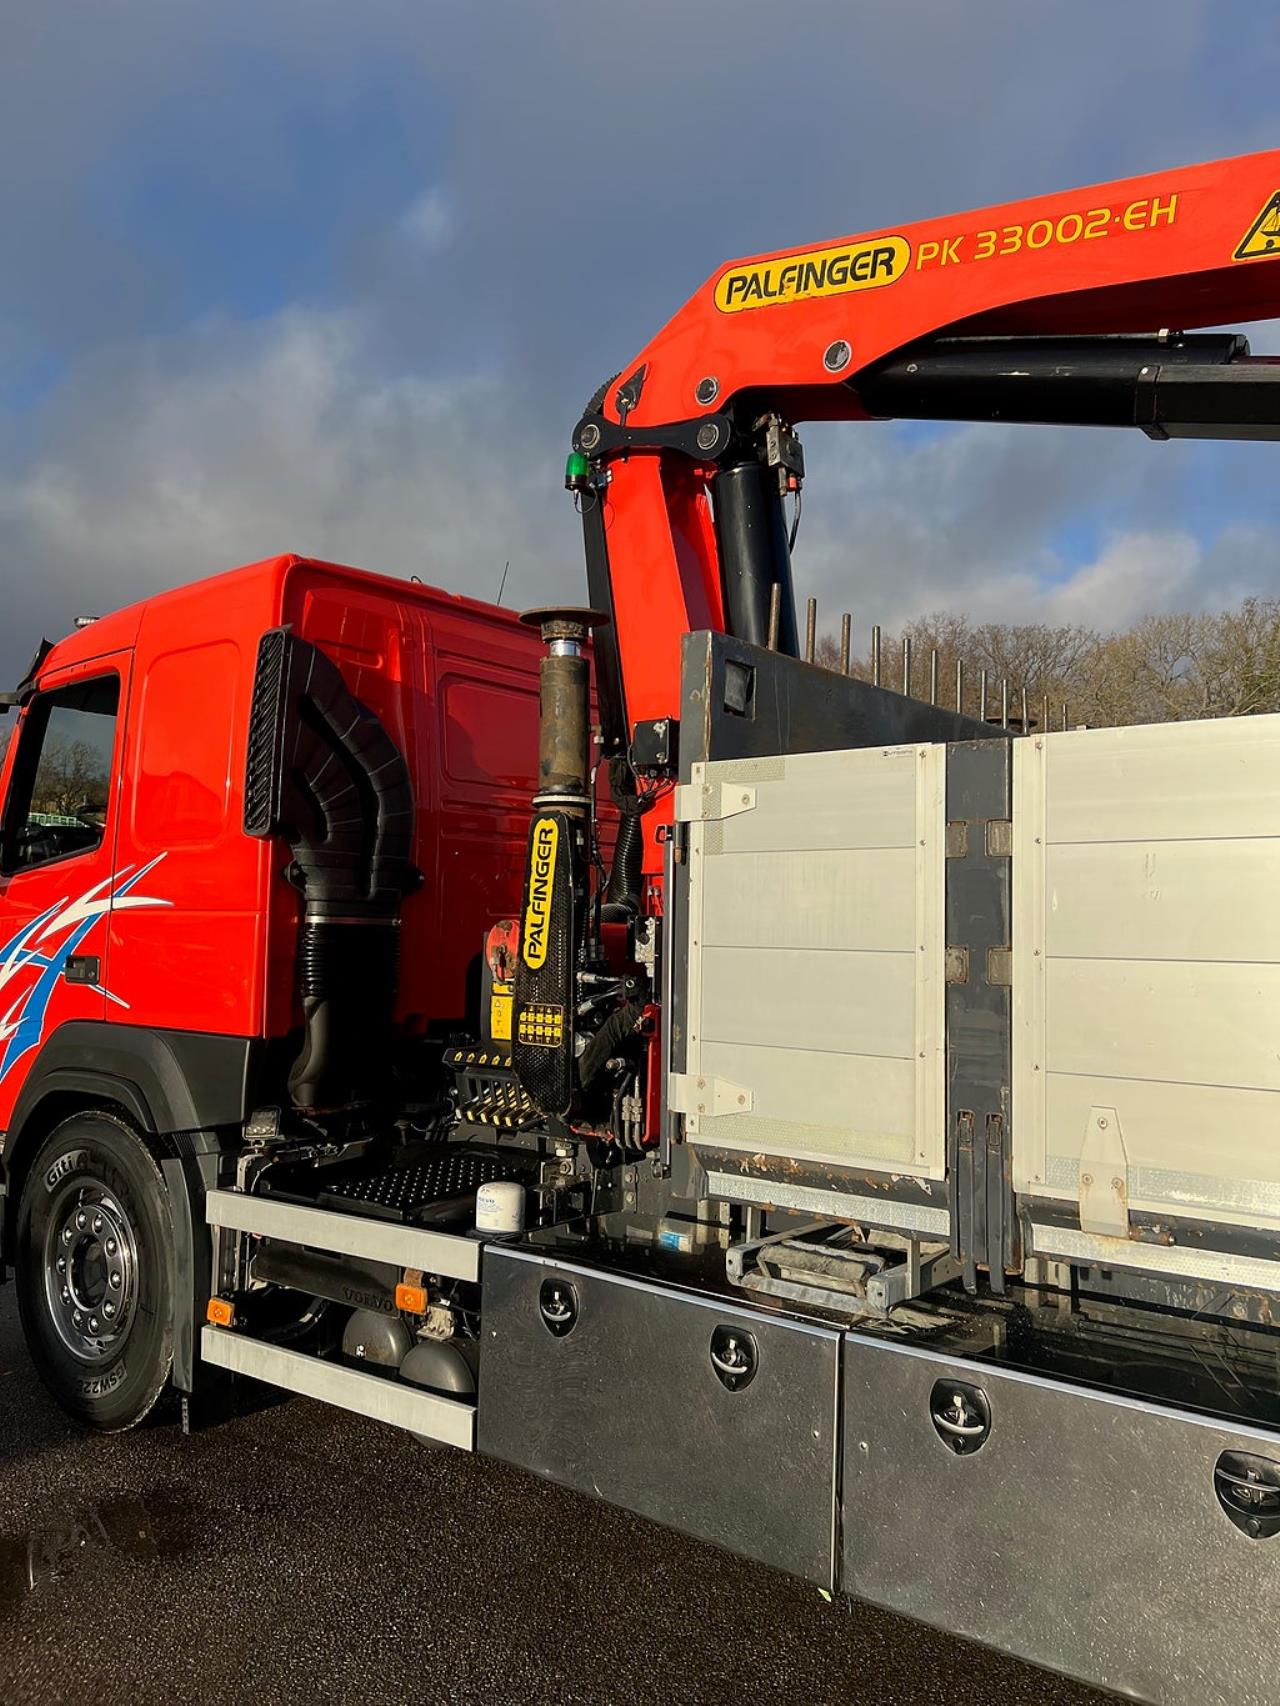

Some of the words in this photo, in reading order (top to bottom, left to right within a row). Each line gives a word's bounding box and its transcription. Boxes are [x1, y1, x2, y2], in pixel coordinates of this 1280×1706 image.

[725, 246, 896, 305] PALFINGER
[915, 235, 963, 271] PK
[527, 827, 554, 959] PALFINGER
[46, 1155, 74, 1187] Giti
